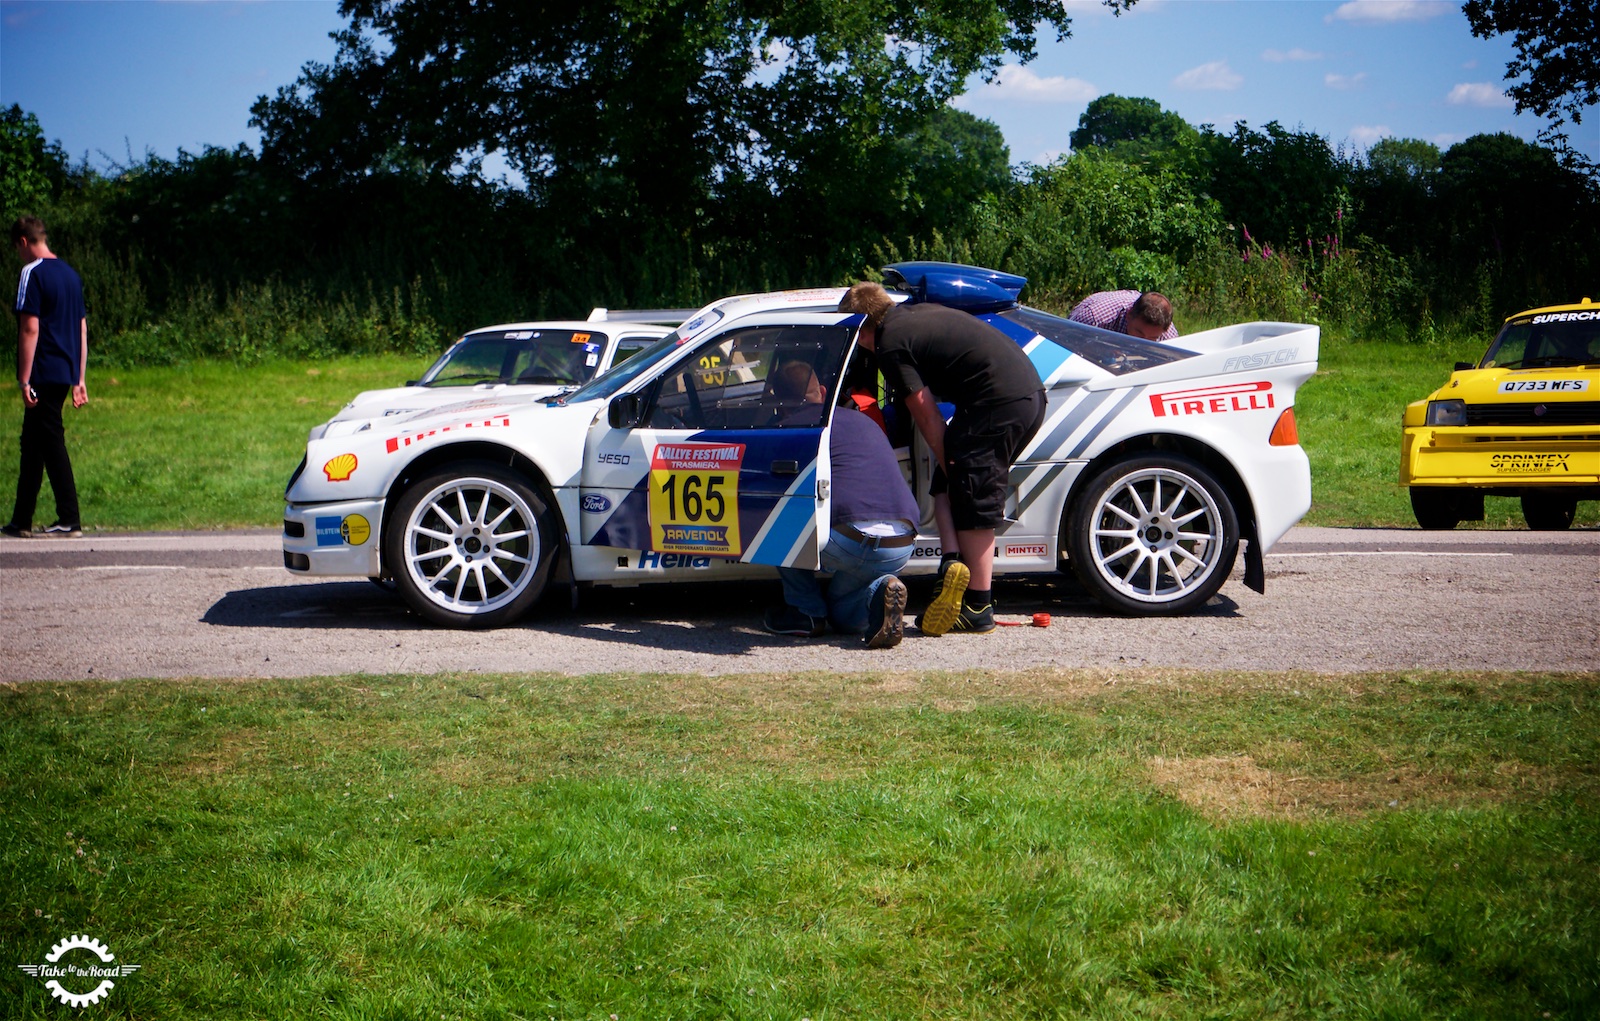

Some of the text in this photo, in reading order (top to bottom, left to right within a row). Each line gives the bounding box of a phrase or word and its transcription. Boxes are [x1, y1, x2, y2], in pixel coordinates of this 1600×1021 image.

[1504, 380, 1584, 392] Q733 WFS
[1149, 381, 1275, 418] PIRELLI
[597, 453, 630, 465] YESO
[656, 445, 740, 461] RALLYE FESTIVAL
[670, 461, 721, 470] TRASMIERA
[1490, 453, 1571, 472] SPRINTEX
[583, 495, 607, 511] Ford
[661, 474, 726, 523] 165
[666, 529, 724, 542] RAVENOL
[1007, 546, 1045, 555] MINTEX
